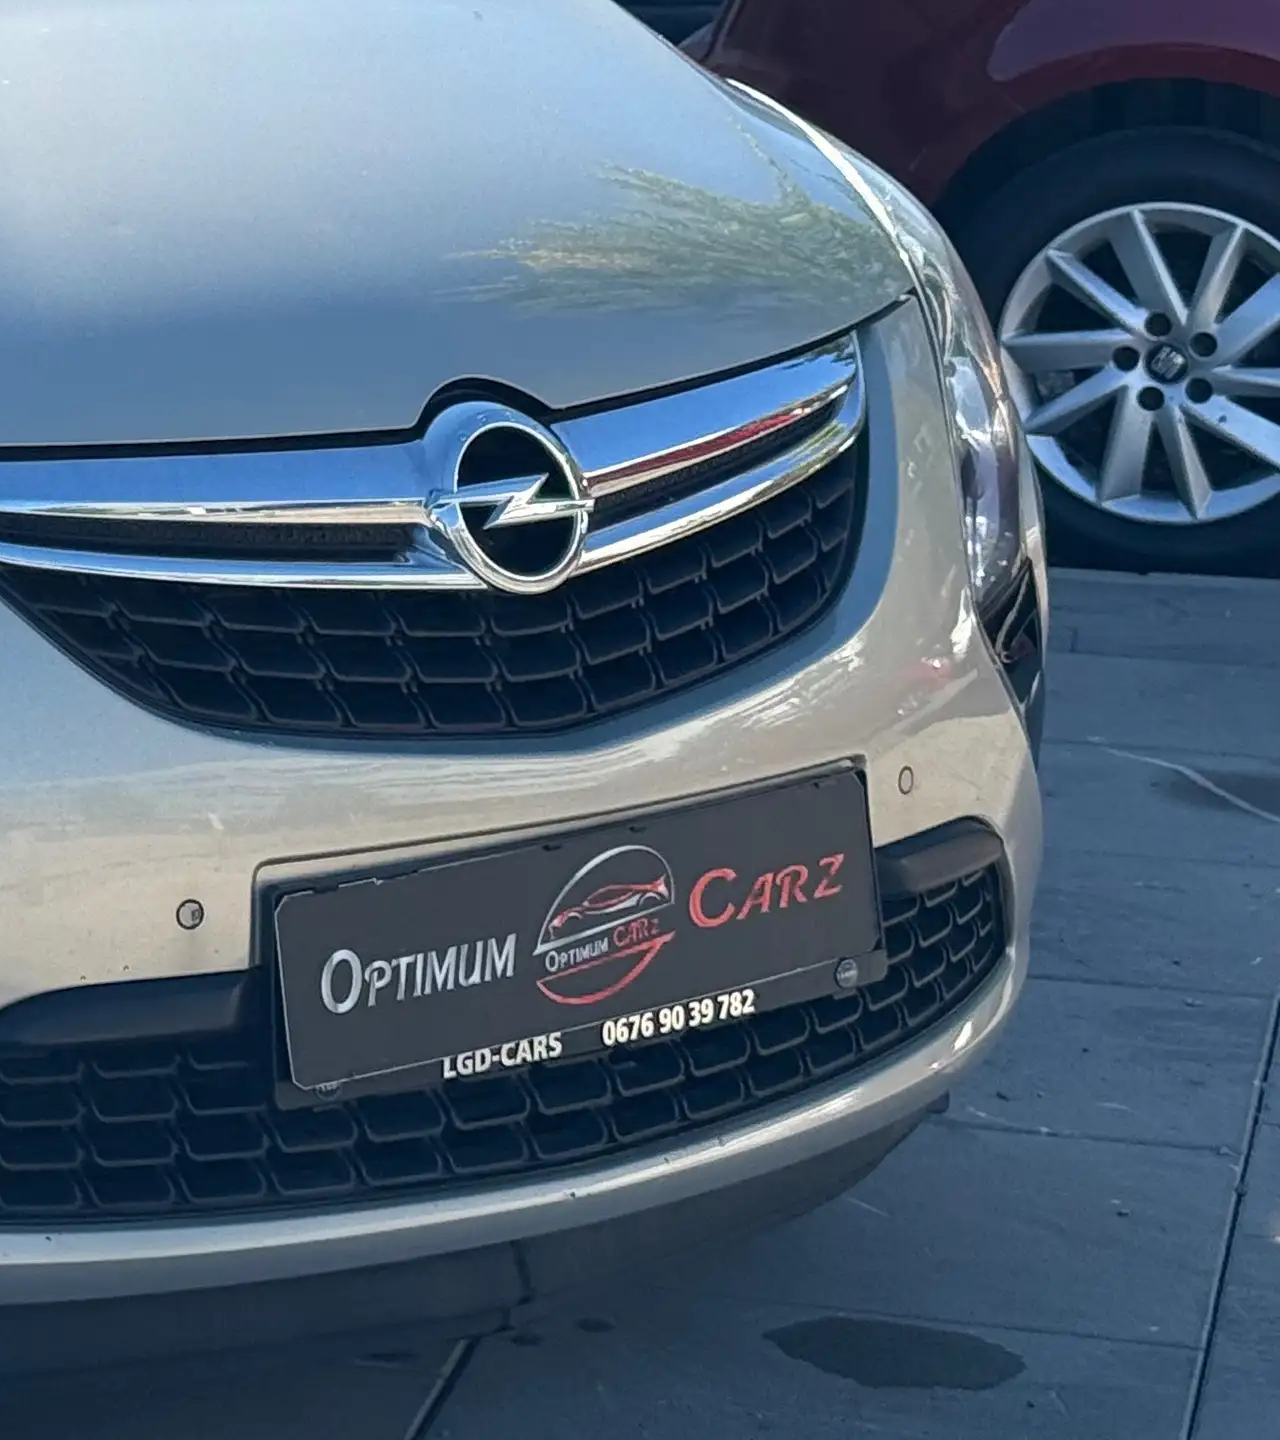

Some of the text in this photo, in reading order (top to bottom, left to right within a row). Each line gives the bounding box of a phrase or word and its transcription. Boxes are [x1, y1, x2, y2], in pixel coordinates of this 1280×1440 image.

[320, 852, 847, 1014] OPTIMUM CARZ
[545, 937, 609, 973] OPTIMUM
[442, 988, 756, 1080] LGD-CARS 0676 90 39 782
